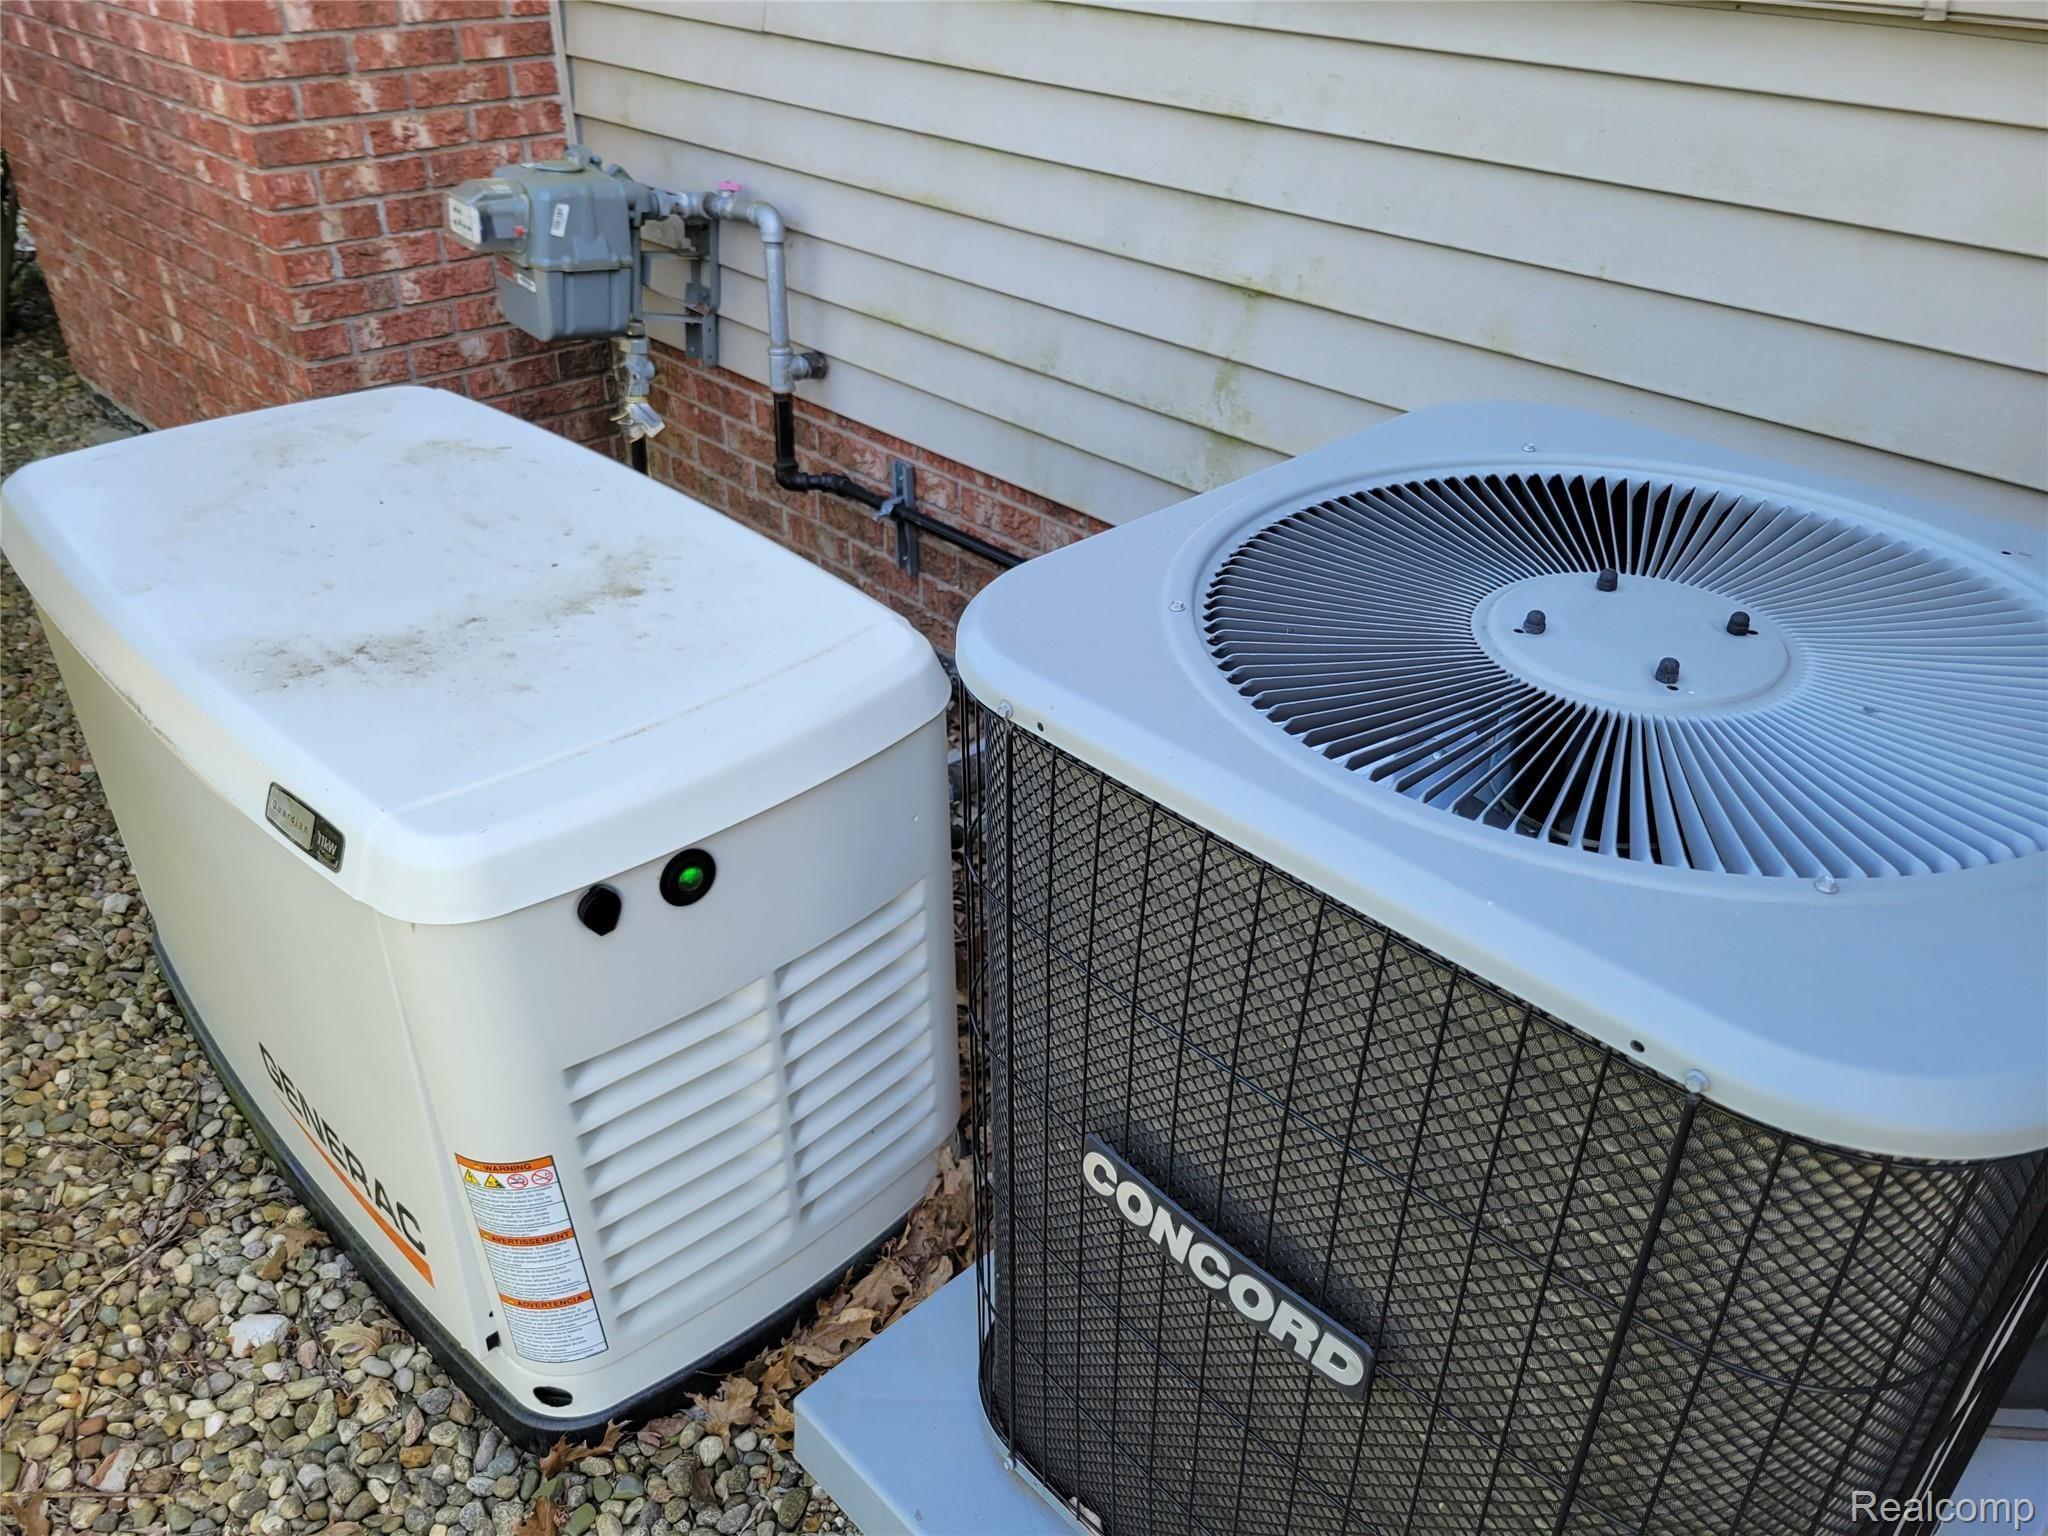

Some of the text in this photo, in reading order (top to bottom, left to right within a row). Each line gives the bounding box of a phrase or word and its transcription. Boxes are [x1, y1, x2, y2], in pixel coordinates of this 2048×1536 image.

[258, 1041, 427, 1256] GENERAC
[483, 1163, 533, 1172] WARNING
[491, 1231, 570, 1245] AVERTISSEMENT
[1082, 1151, 1364, 1386] CONCORD
[516, 1296, 584, 1308] ADVERTENCIA
